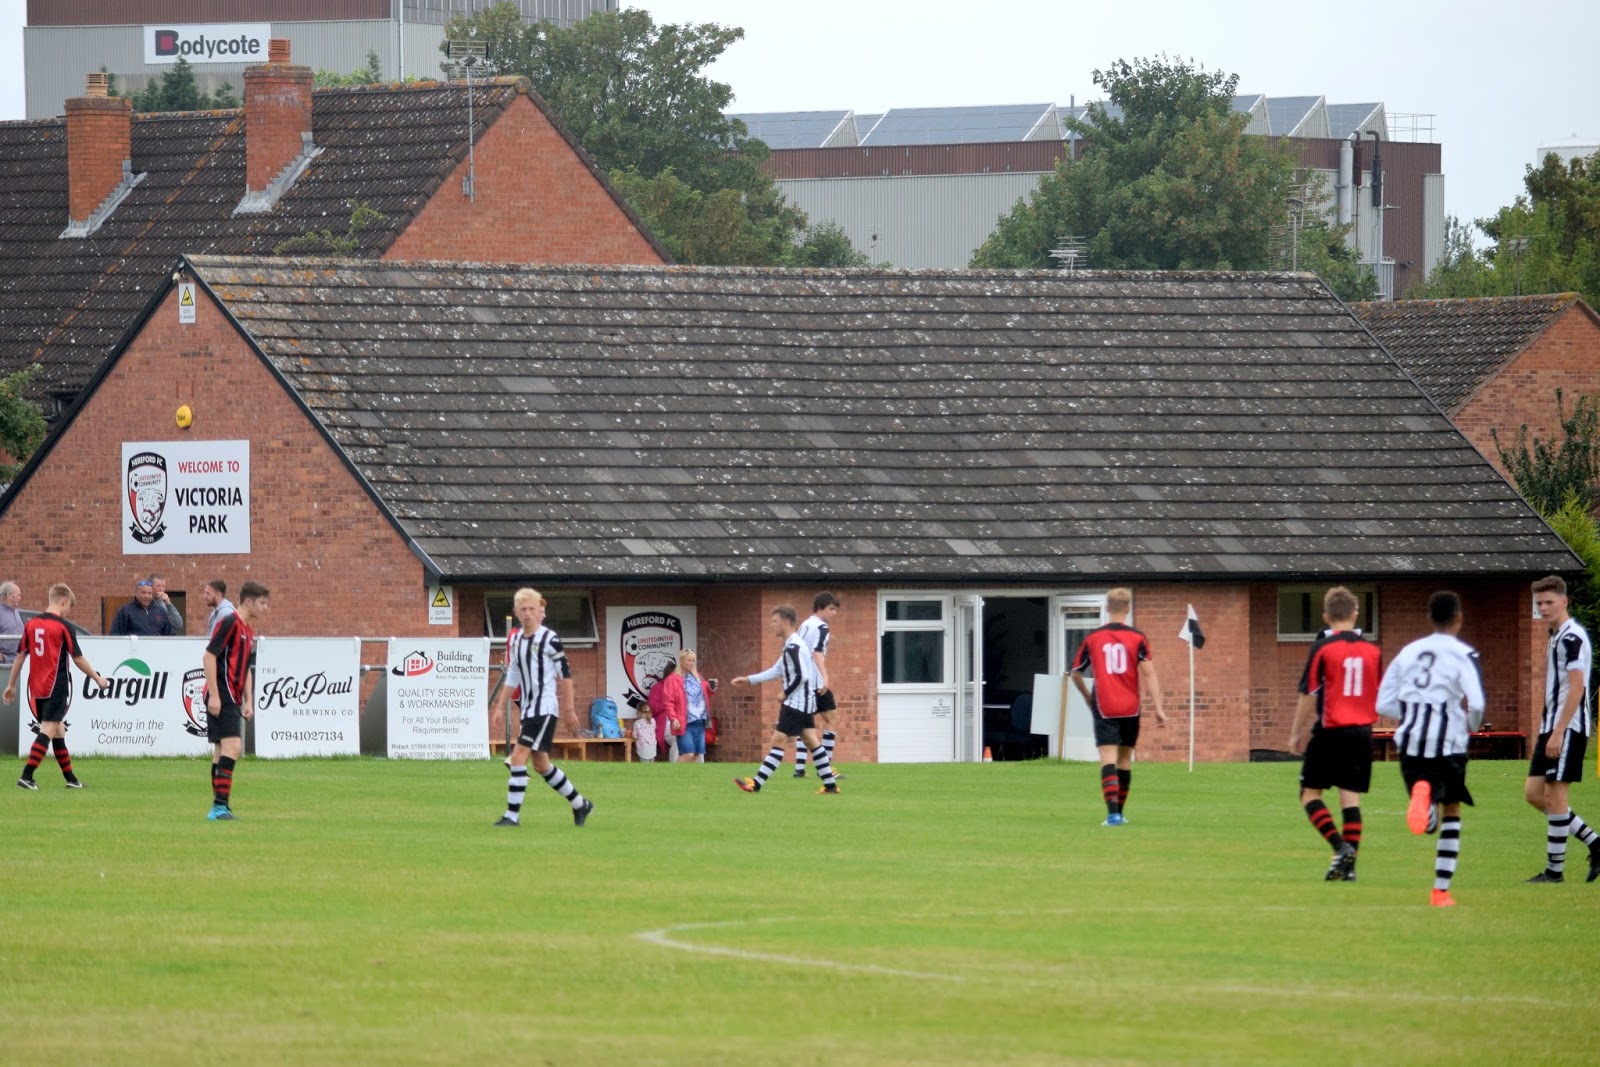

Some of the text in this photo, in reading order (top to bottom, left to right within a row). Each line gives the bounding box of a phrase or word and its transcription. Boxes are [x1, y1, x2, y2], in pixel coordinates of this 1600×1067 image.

[155, 30, 260, 59] Bodycote
[131, 456, 163, 466] HEREFORD FC
[178, 460, 240, 473] WELCOME TO
[175, 487, 243, 506] VICTORIA
[189, 514, 228, 533] PARK
[626, 616, 676, 628] HEREFORD FC
[34, 628, 45, 657] 5
[638, 641, 673, 651] COMMUNITY
[437, 651, 473, 663] Building
[1102, 643, 1127, 674] 10
[436, 663, 485, 673] Contractors
[1413, 651, 1436, 689] 3
[1343, 657, 1364, 697] 11
[82, 671, 168, 706] Cargill
[398, 688, 476, 698] QUALITY SERVICE
[399, 700, 475, 709] & WORKMANSHIP
[91, 719, 164, 732] Working in the
[402, 716, 470, 725] For All Your Building
[271, 731, 344, 741] 07941027134
[412, 726, 459, 735] Requirements
[98, 733, 156, 746] Community
